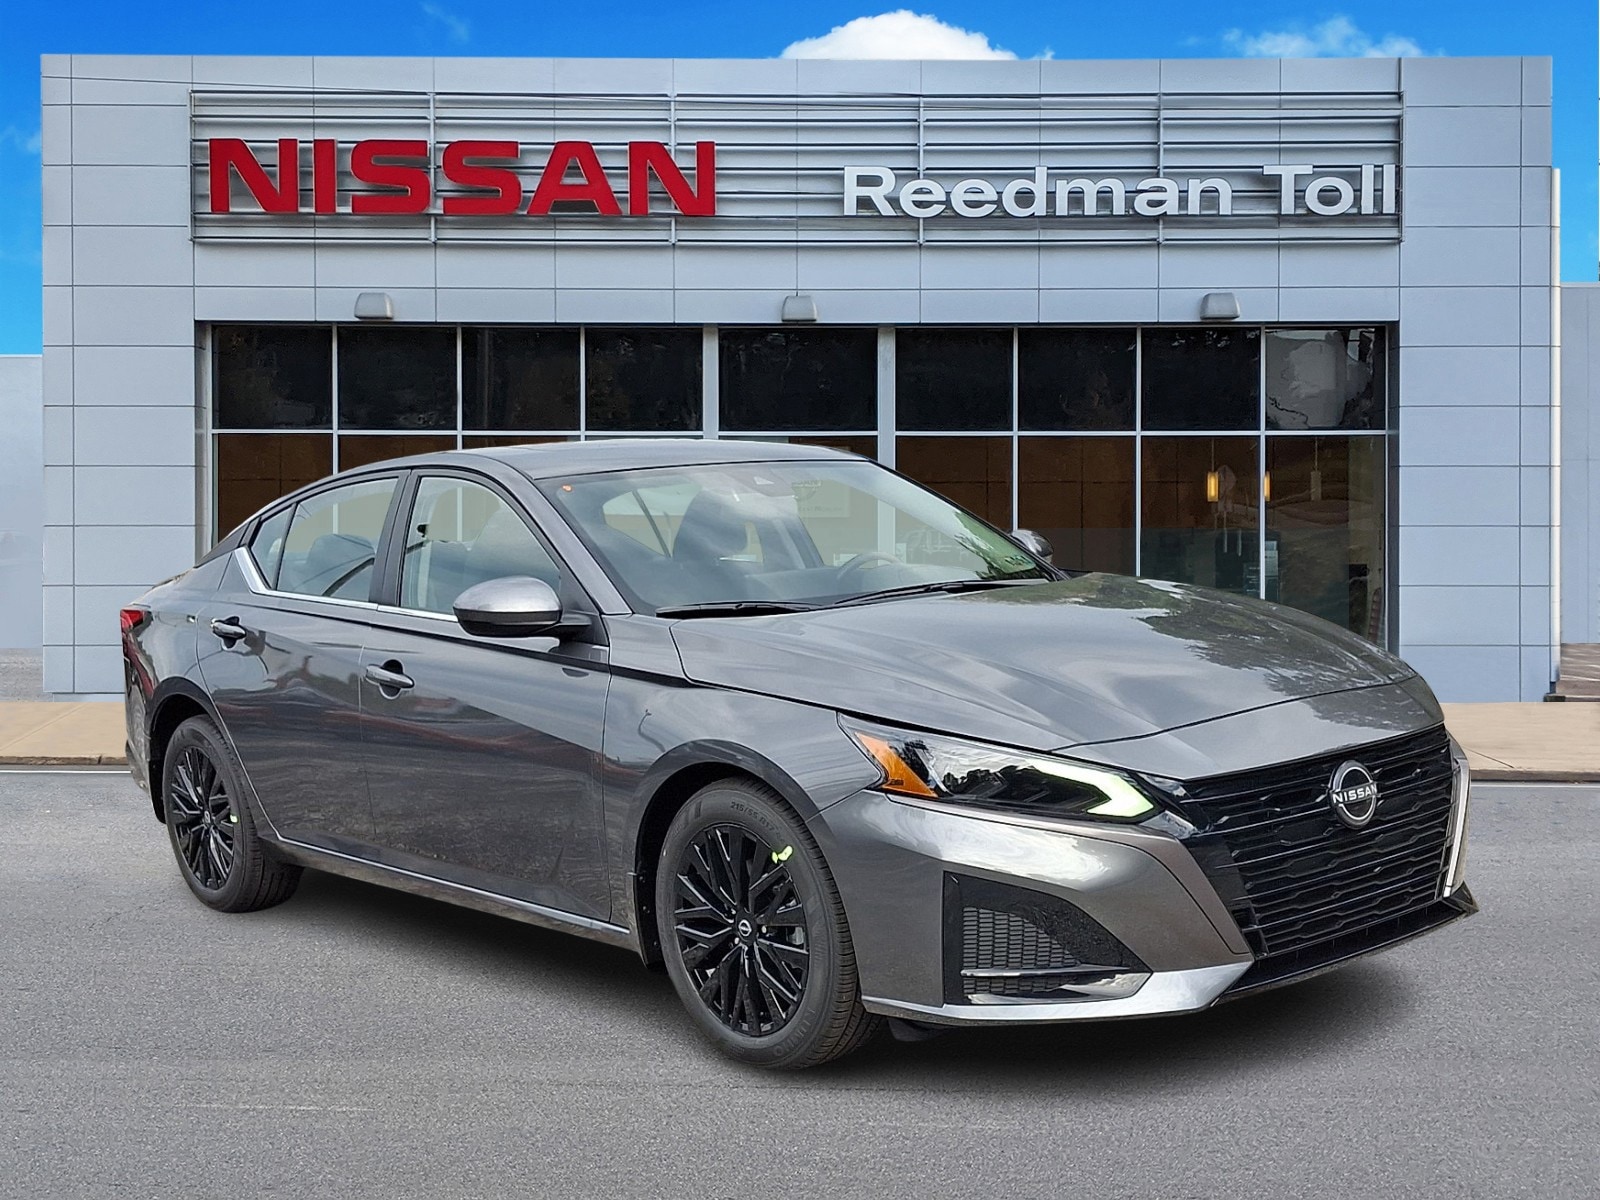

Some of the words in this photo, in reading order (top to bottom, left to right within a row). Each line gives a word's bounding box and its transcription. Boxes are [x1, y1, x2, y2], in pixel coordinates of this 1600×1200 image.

[208, 138, 717, 217] NISSAN
[842, 165, 1233, 218] Reedman
[1262, 164, 1396, 216] Toll
[730, 801, 759, 819] 215/55
[1332, 783, 1378, 804] NISSAN
